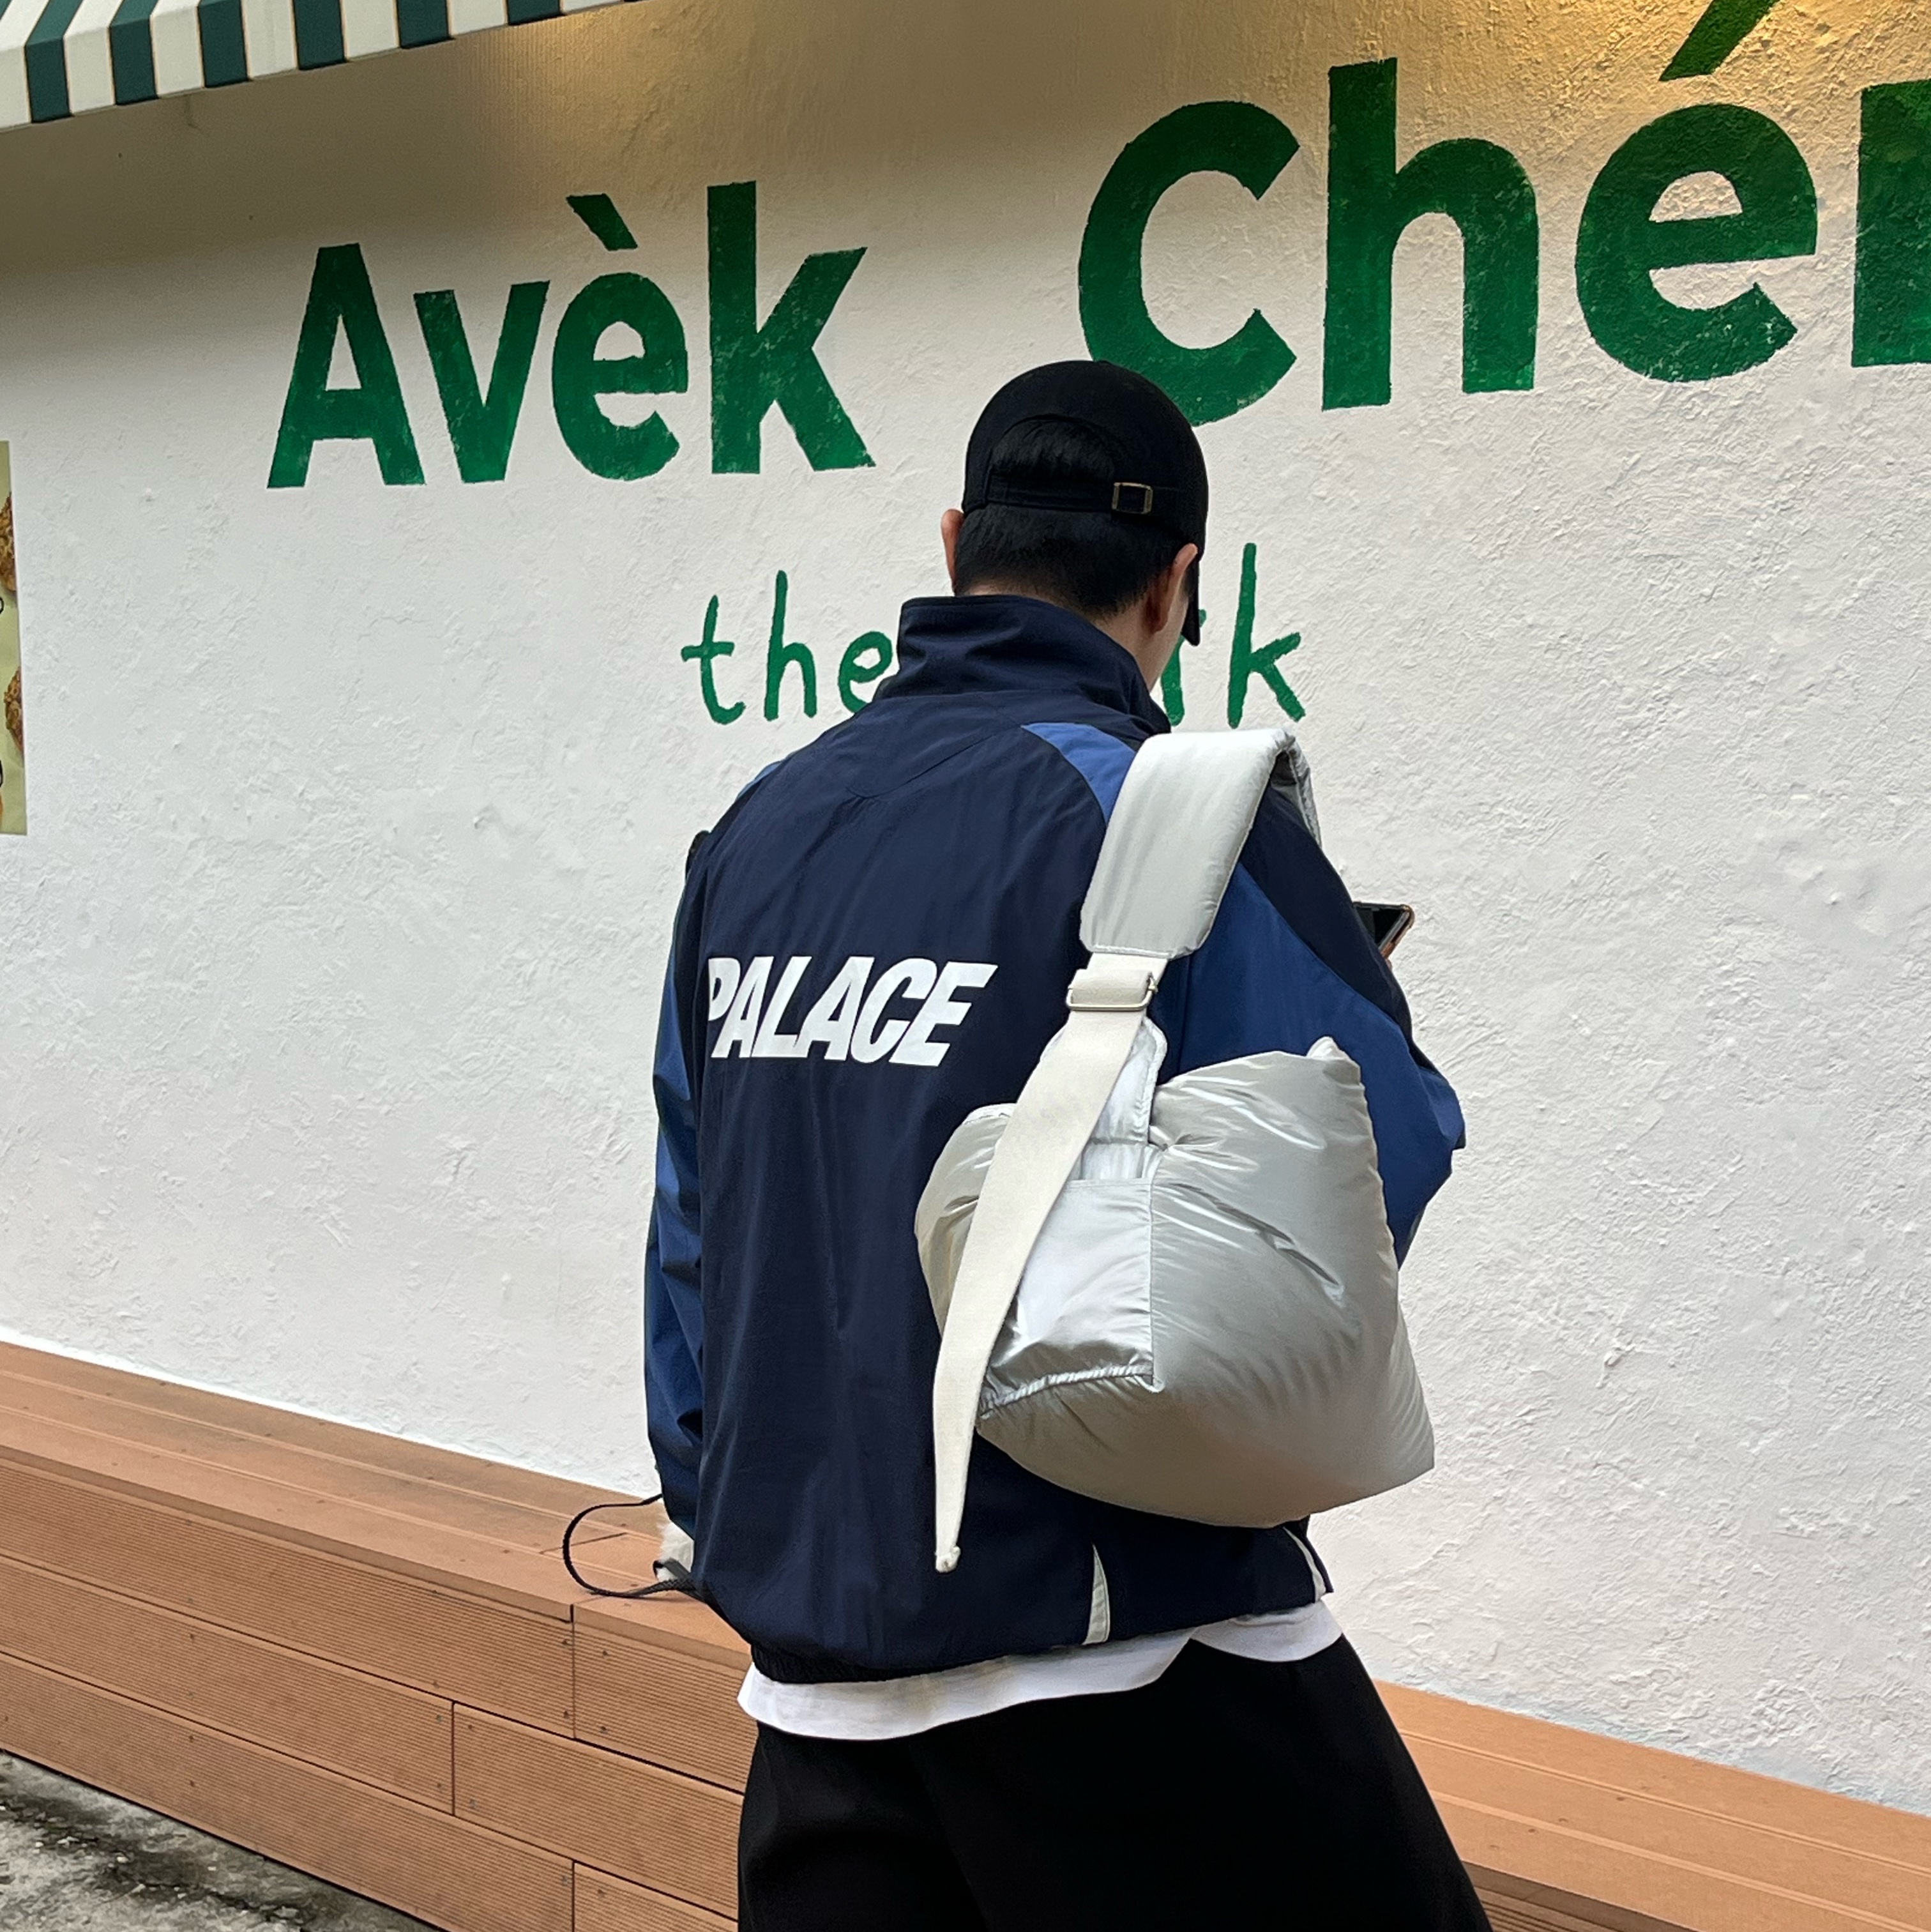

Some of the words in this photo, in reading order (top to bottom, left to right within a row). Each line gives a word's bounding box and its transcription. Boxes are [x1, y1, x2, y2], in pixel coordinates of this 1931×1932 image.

[267, 181, 876, 489] Avèk
[681, 570, 893, 725] the
[708, 955, 998, 1067] PALACE
